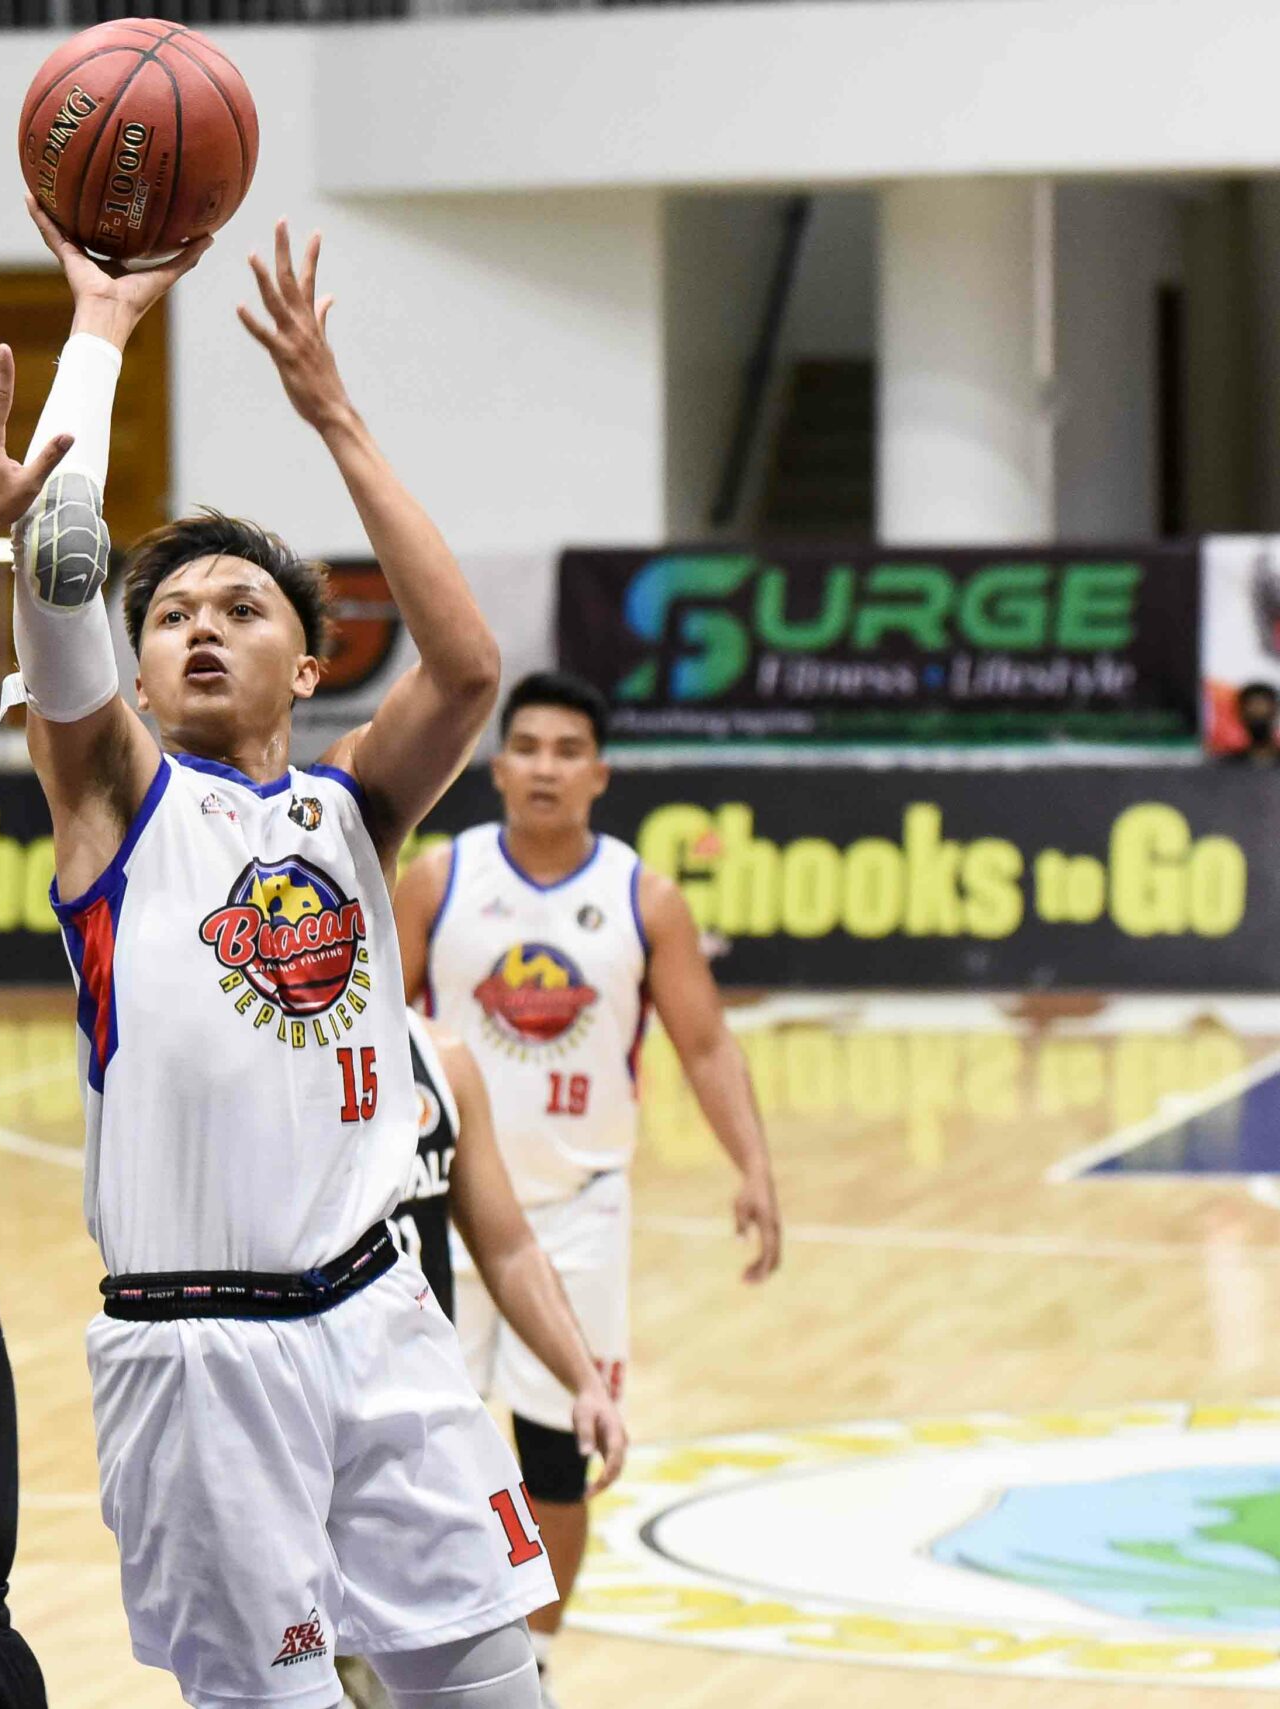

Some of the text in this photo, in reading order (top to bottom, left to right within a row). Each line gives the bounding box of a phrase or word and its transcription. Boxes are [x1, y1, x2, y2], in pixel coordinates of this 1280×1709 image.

[617, 553, 1144, 698] SURGE
[637, 800, 1247, 939] Chooks to Go
[199, 898, 366, 967] Bacan
[336, 1046, 378, 1122] 15
[546, 1071, 590, 1116] 19
[488, 1480, 544, 1568] 1
